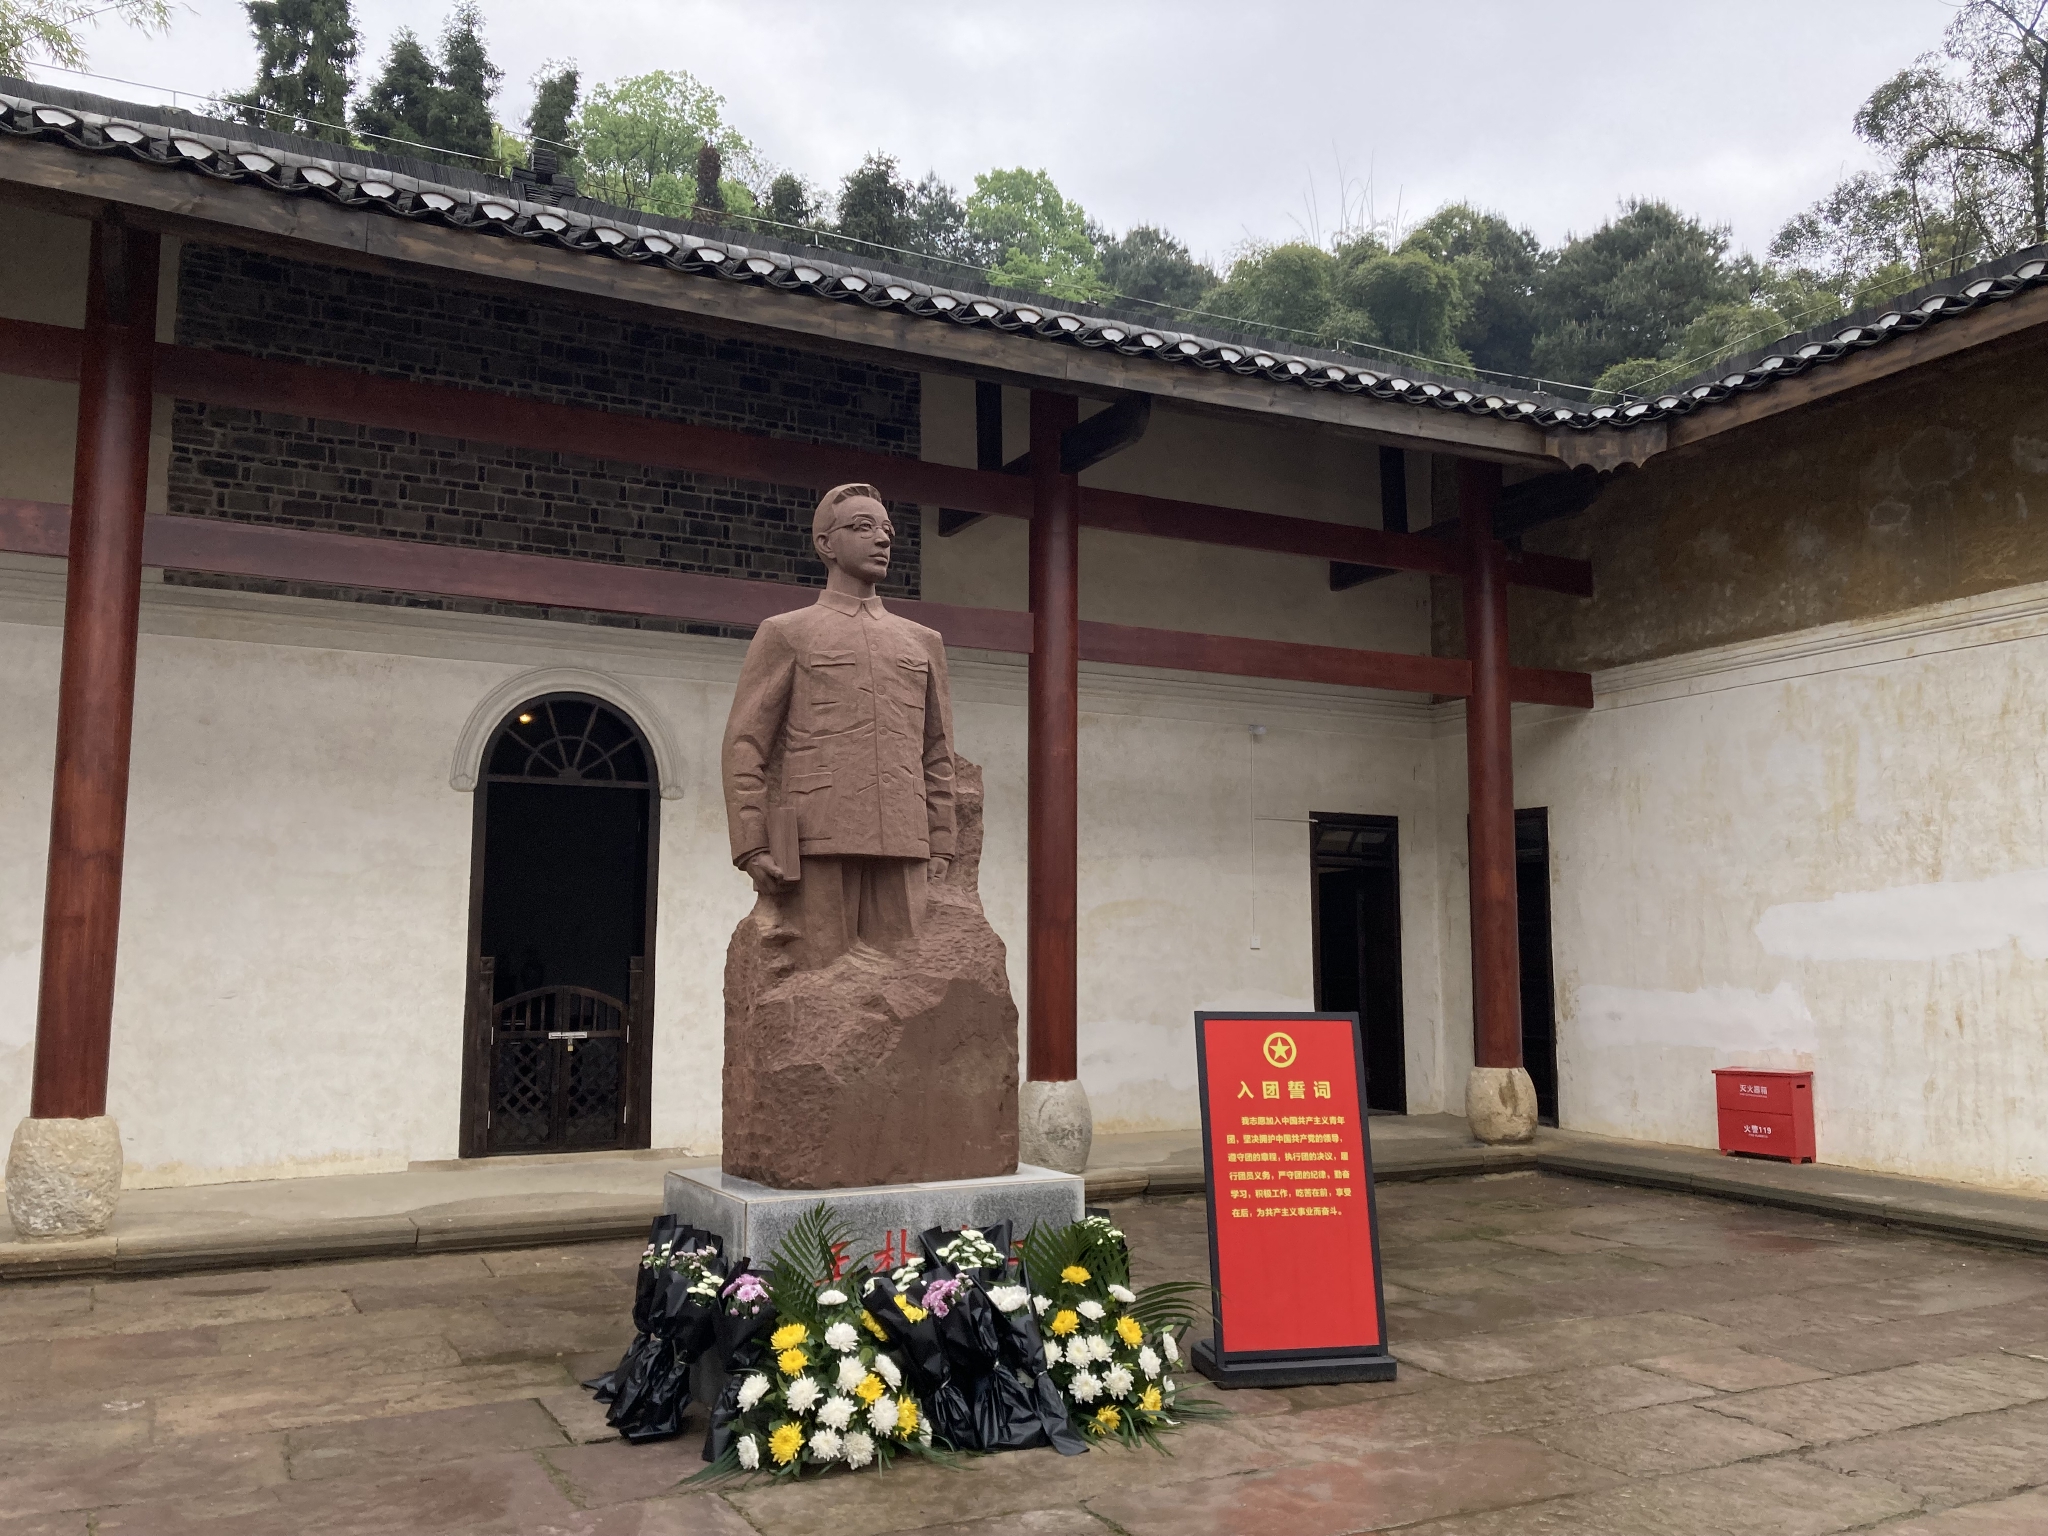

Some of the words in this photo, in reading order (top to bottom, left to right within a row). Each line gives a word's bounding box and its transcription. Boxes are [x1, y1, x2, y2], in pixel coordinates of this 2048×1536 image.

[1237, 1080, 1332, 1099] 入团誓词
[1739, 1084, 1768, 1095] 灭火器箱
[1241, 1115, 1346, 1126] 我志愿加入中国共产主义青年
[1743, 1124, 1772, 1136] 火警119
